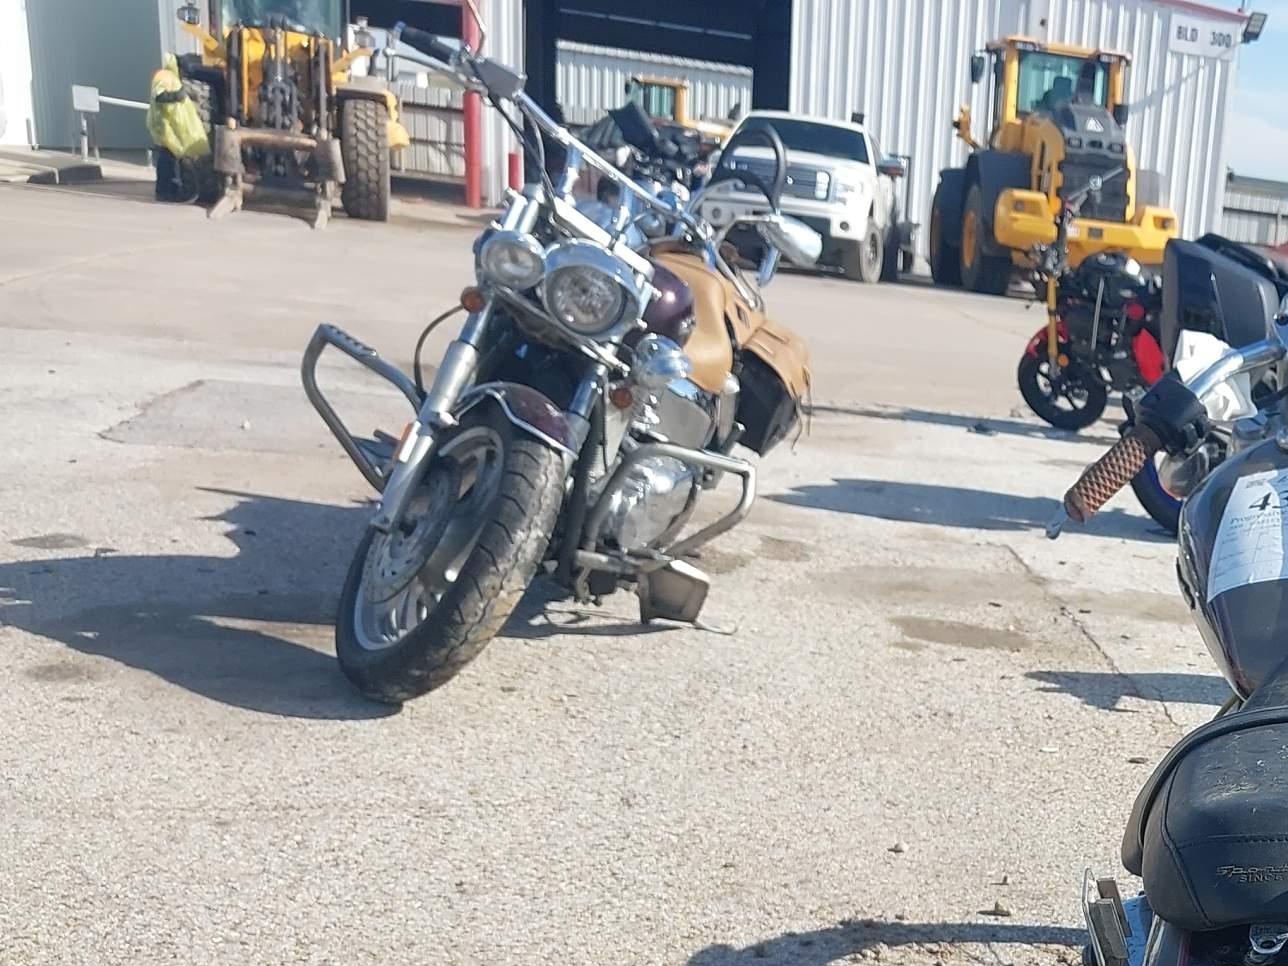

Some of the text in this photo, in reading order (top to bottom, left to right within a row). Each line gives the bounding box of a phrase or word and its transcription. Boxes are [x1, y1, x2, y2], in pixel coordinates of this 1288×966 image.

[1176, 25, 1232, 49] BLD 300
[1239, 874, 1284, 883] SINCE
